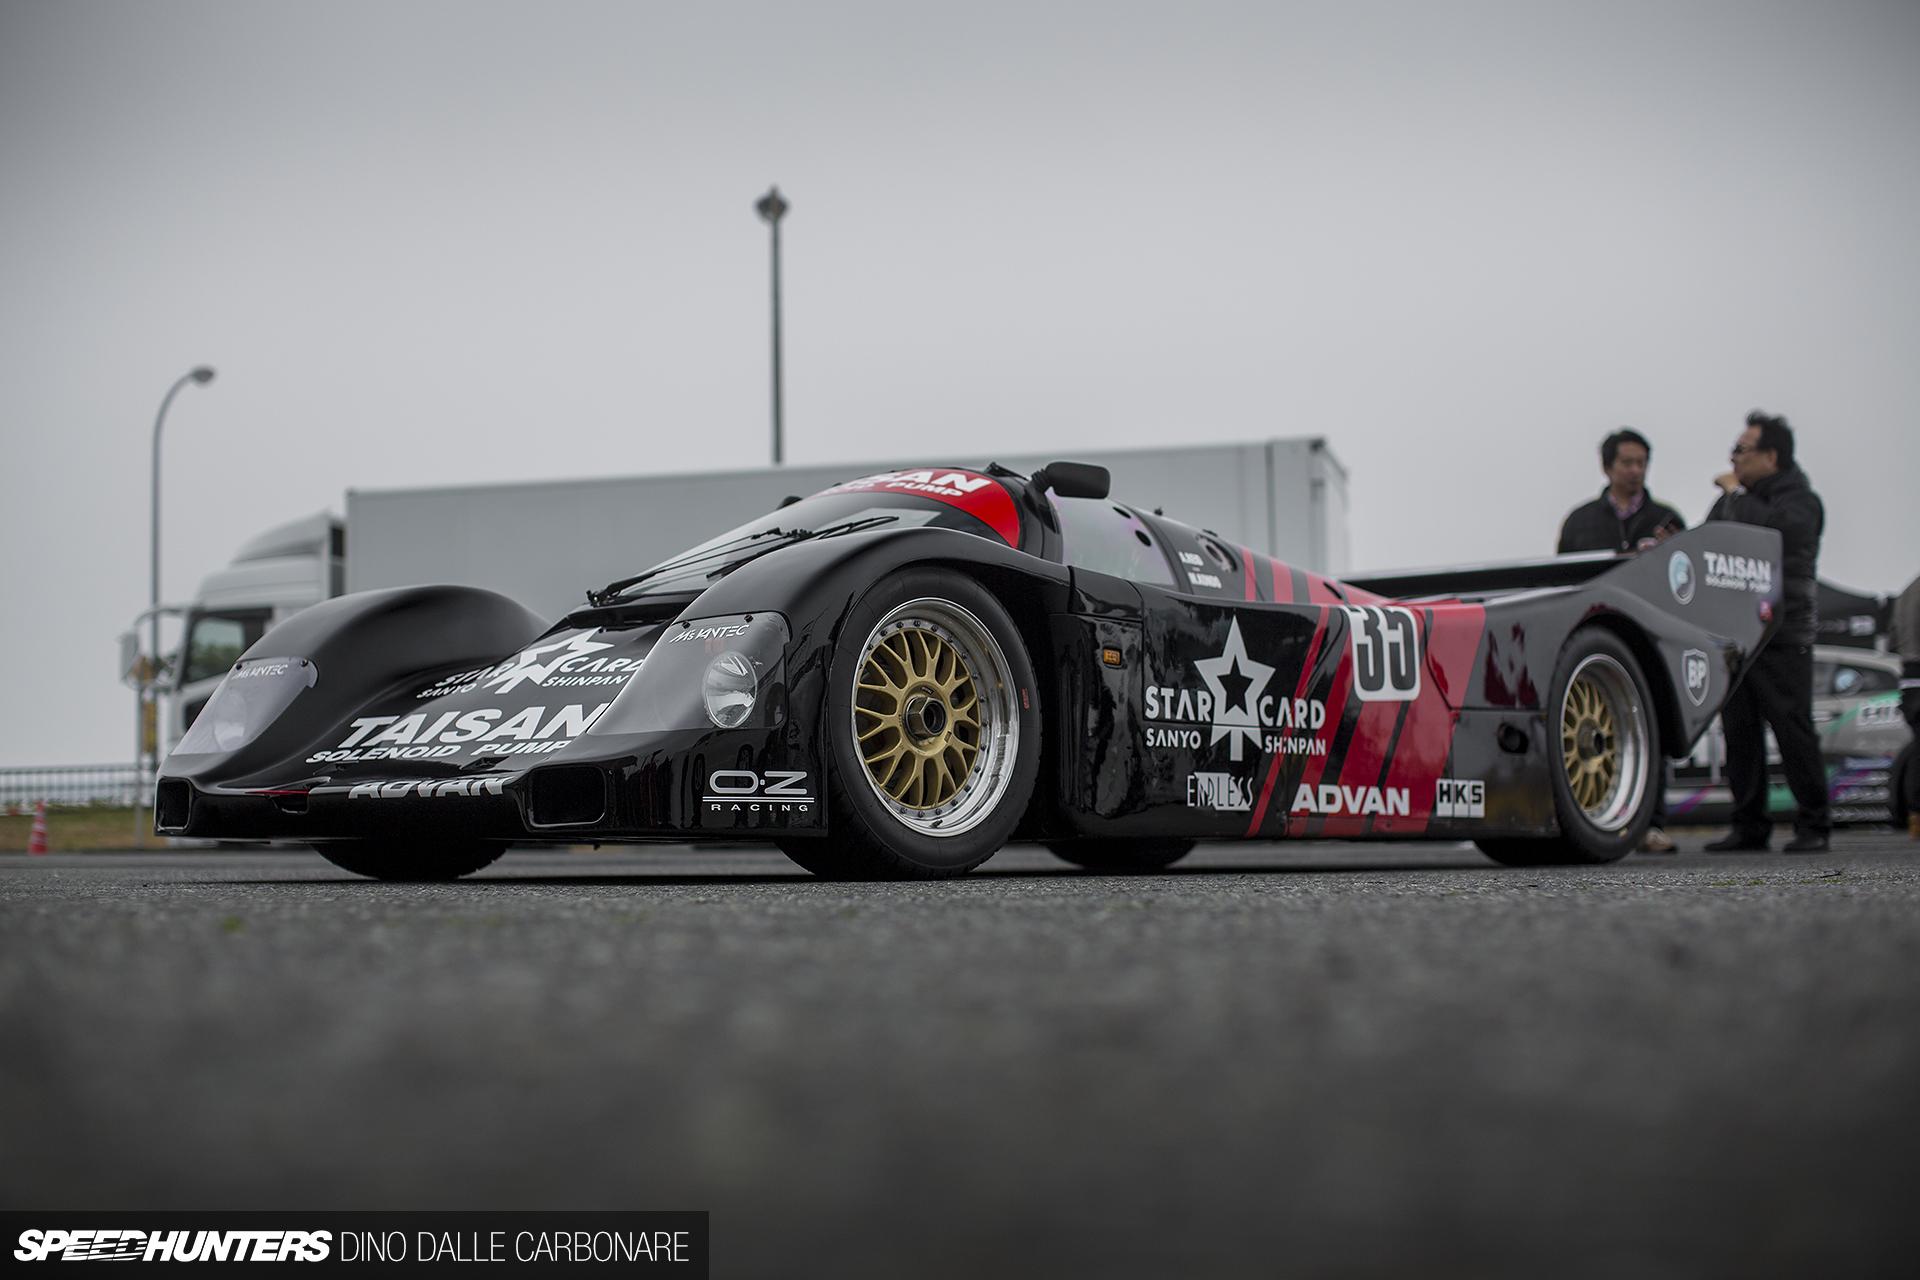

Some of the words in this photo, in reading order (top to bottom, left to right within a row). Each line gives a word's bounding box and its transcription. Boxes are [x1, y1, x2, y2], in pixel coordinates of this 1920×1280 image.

[885, 482, 963, 497] PUMP
[1703, 551, 1771, 581] TAISAN
[1356, 607, 1417, 692] 35
[416, 682, 477, 698] SANYO
[542, 674, 629, 688] SHINPAN
[435, 662, 514, 687] STAR
[1688, 659, 1706, 688] BP
[1145, 685, 1212, 722] STAR
[1259, 695, 1326, 729] CARD
[338, 702, 610, 749] TAISAN
[305, 744, 459, 764] SOLENOID
[470, 740, 572, 756] PUMP
[1146, 728, 1201, 749] SANYO
[1265, 735, 1326, 756] SHINPAN
[348, 776, 506, 799] ADVAN
[1291, 783, 1410, 816] ADVAN
[1438, 781, 1483, 807] HKS
[711, 804, 808, 812] RACING
